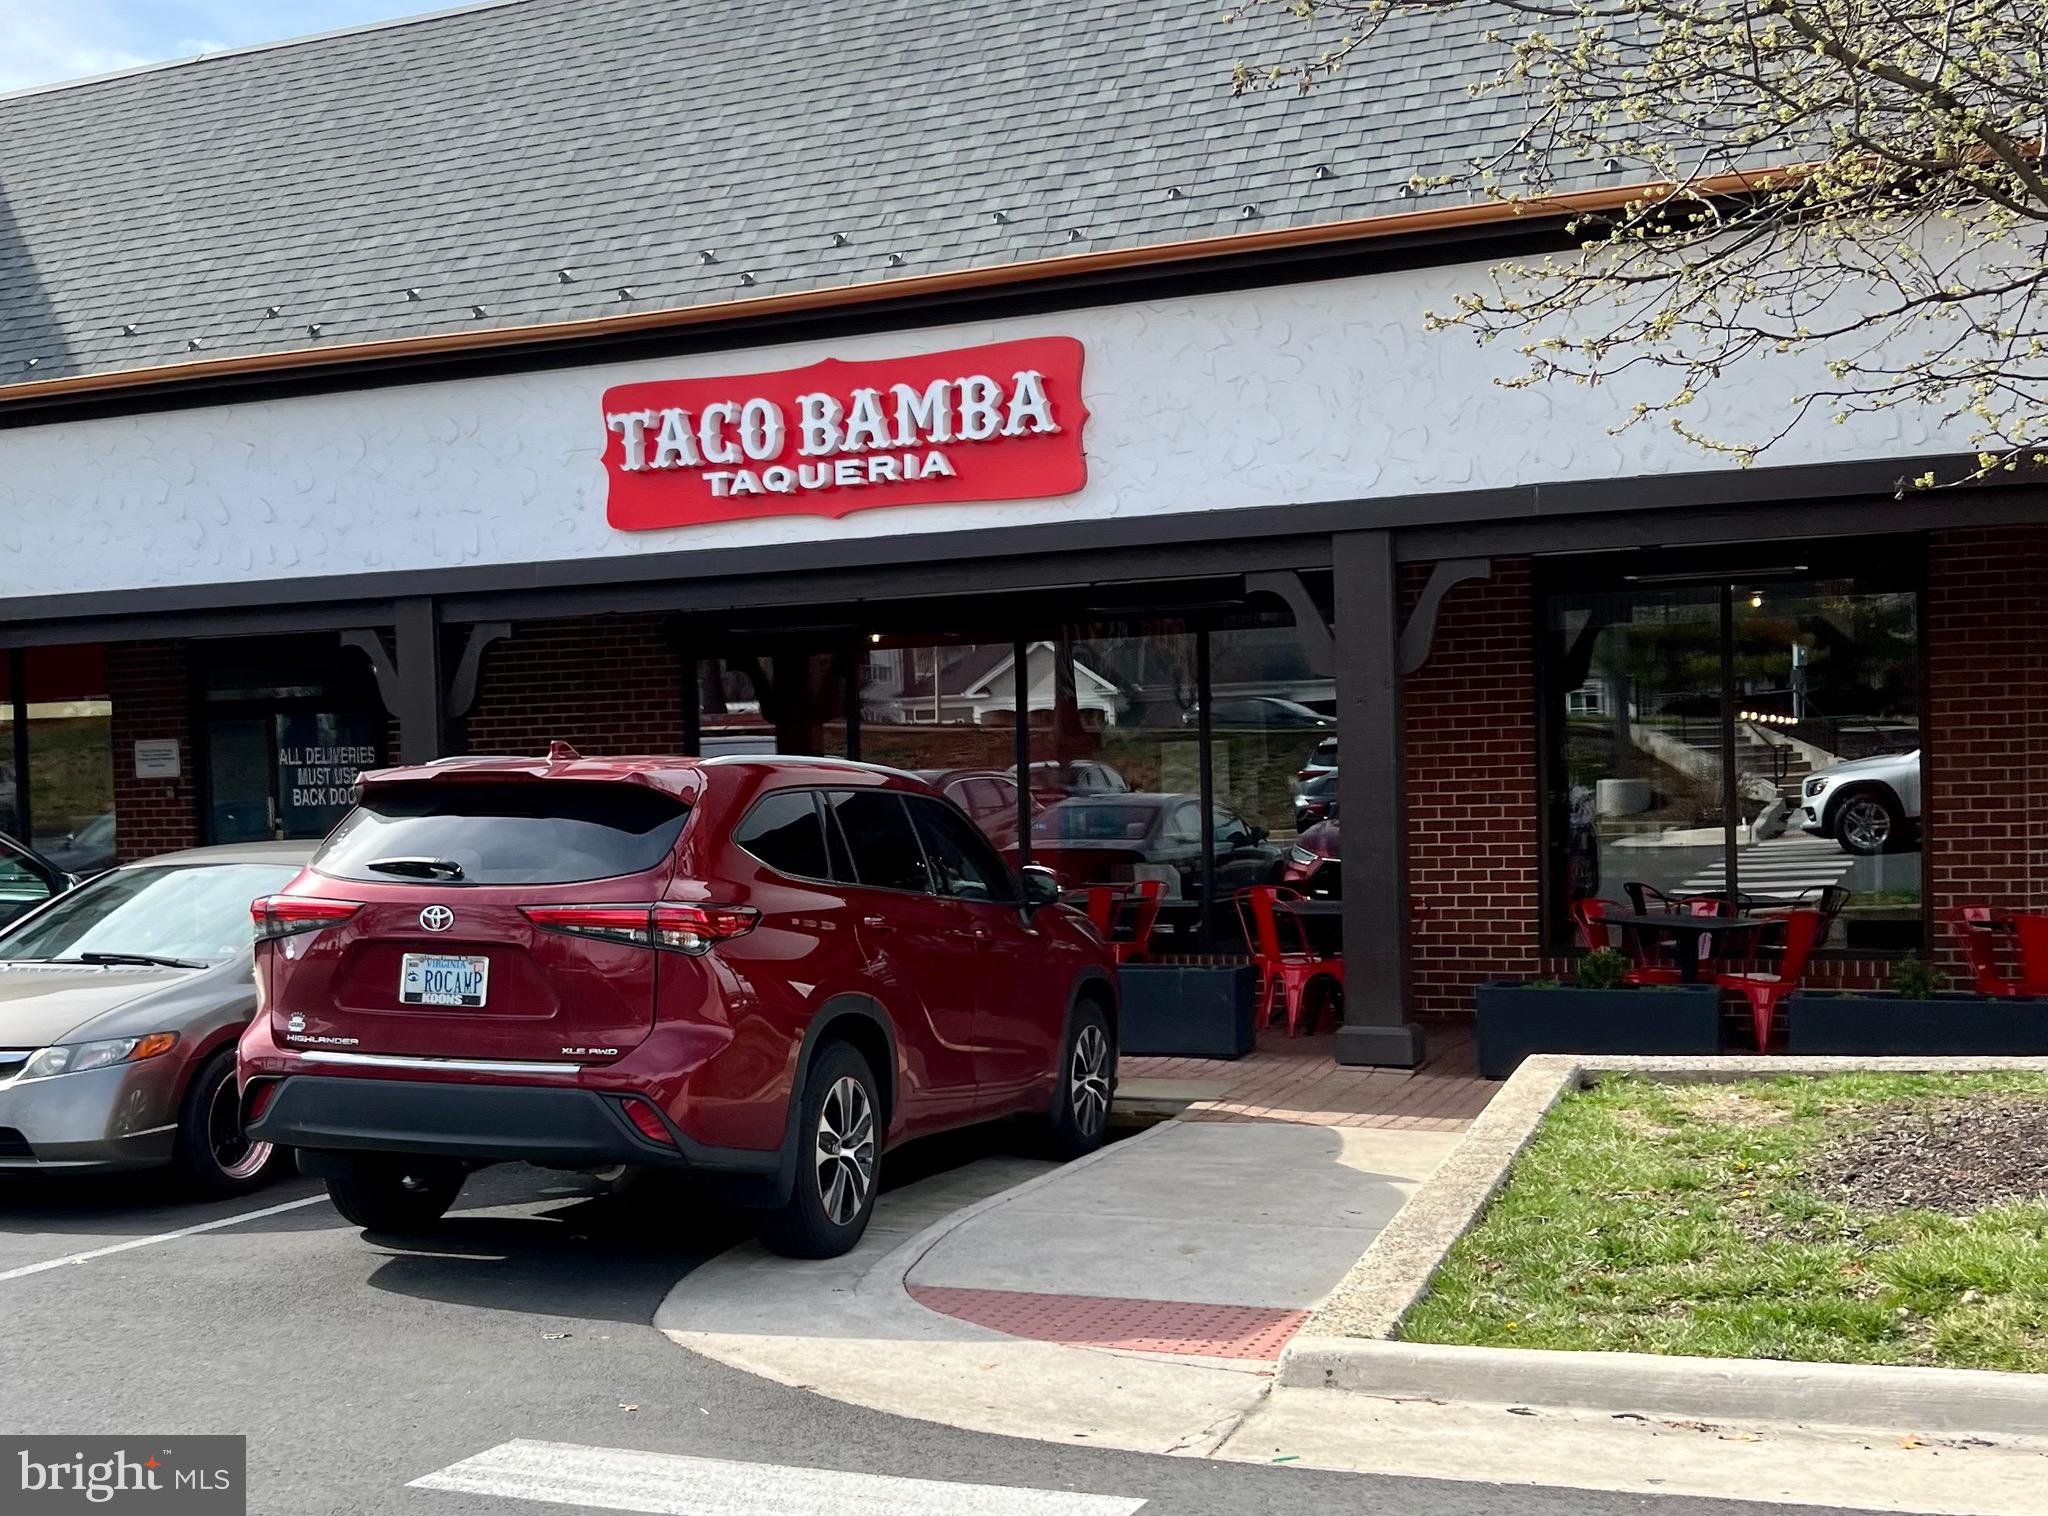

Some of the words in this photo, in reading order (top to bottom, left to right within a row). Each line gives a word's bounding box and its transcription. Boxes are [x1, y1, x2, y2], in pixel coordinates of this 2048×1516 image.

[607, 397, 786, 472] TACO
[796, 369, 1062, 457] BAMBA
[702, 450, 957, 498] TAQUERIA
[280, 747, 302, 765] ALL
[305, 746, 375, 765] DELIVERIES
[298, 767, 330, 785] MUST
[293, 788, 326, 806] BACK
[426, 959, 466, 969] VIRGINIA
[422, 992, 463, 1005] KOONS
[286, 1034, 359, 1045] HIGHLANDER
[561, 1047, 586, 1055] XLE
[588, 1047, 618, 1055] AWD
